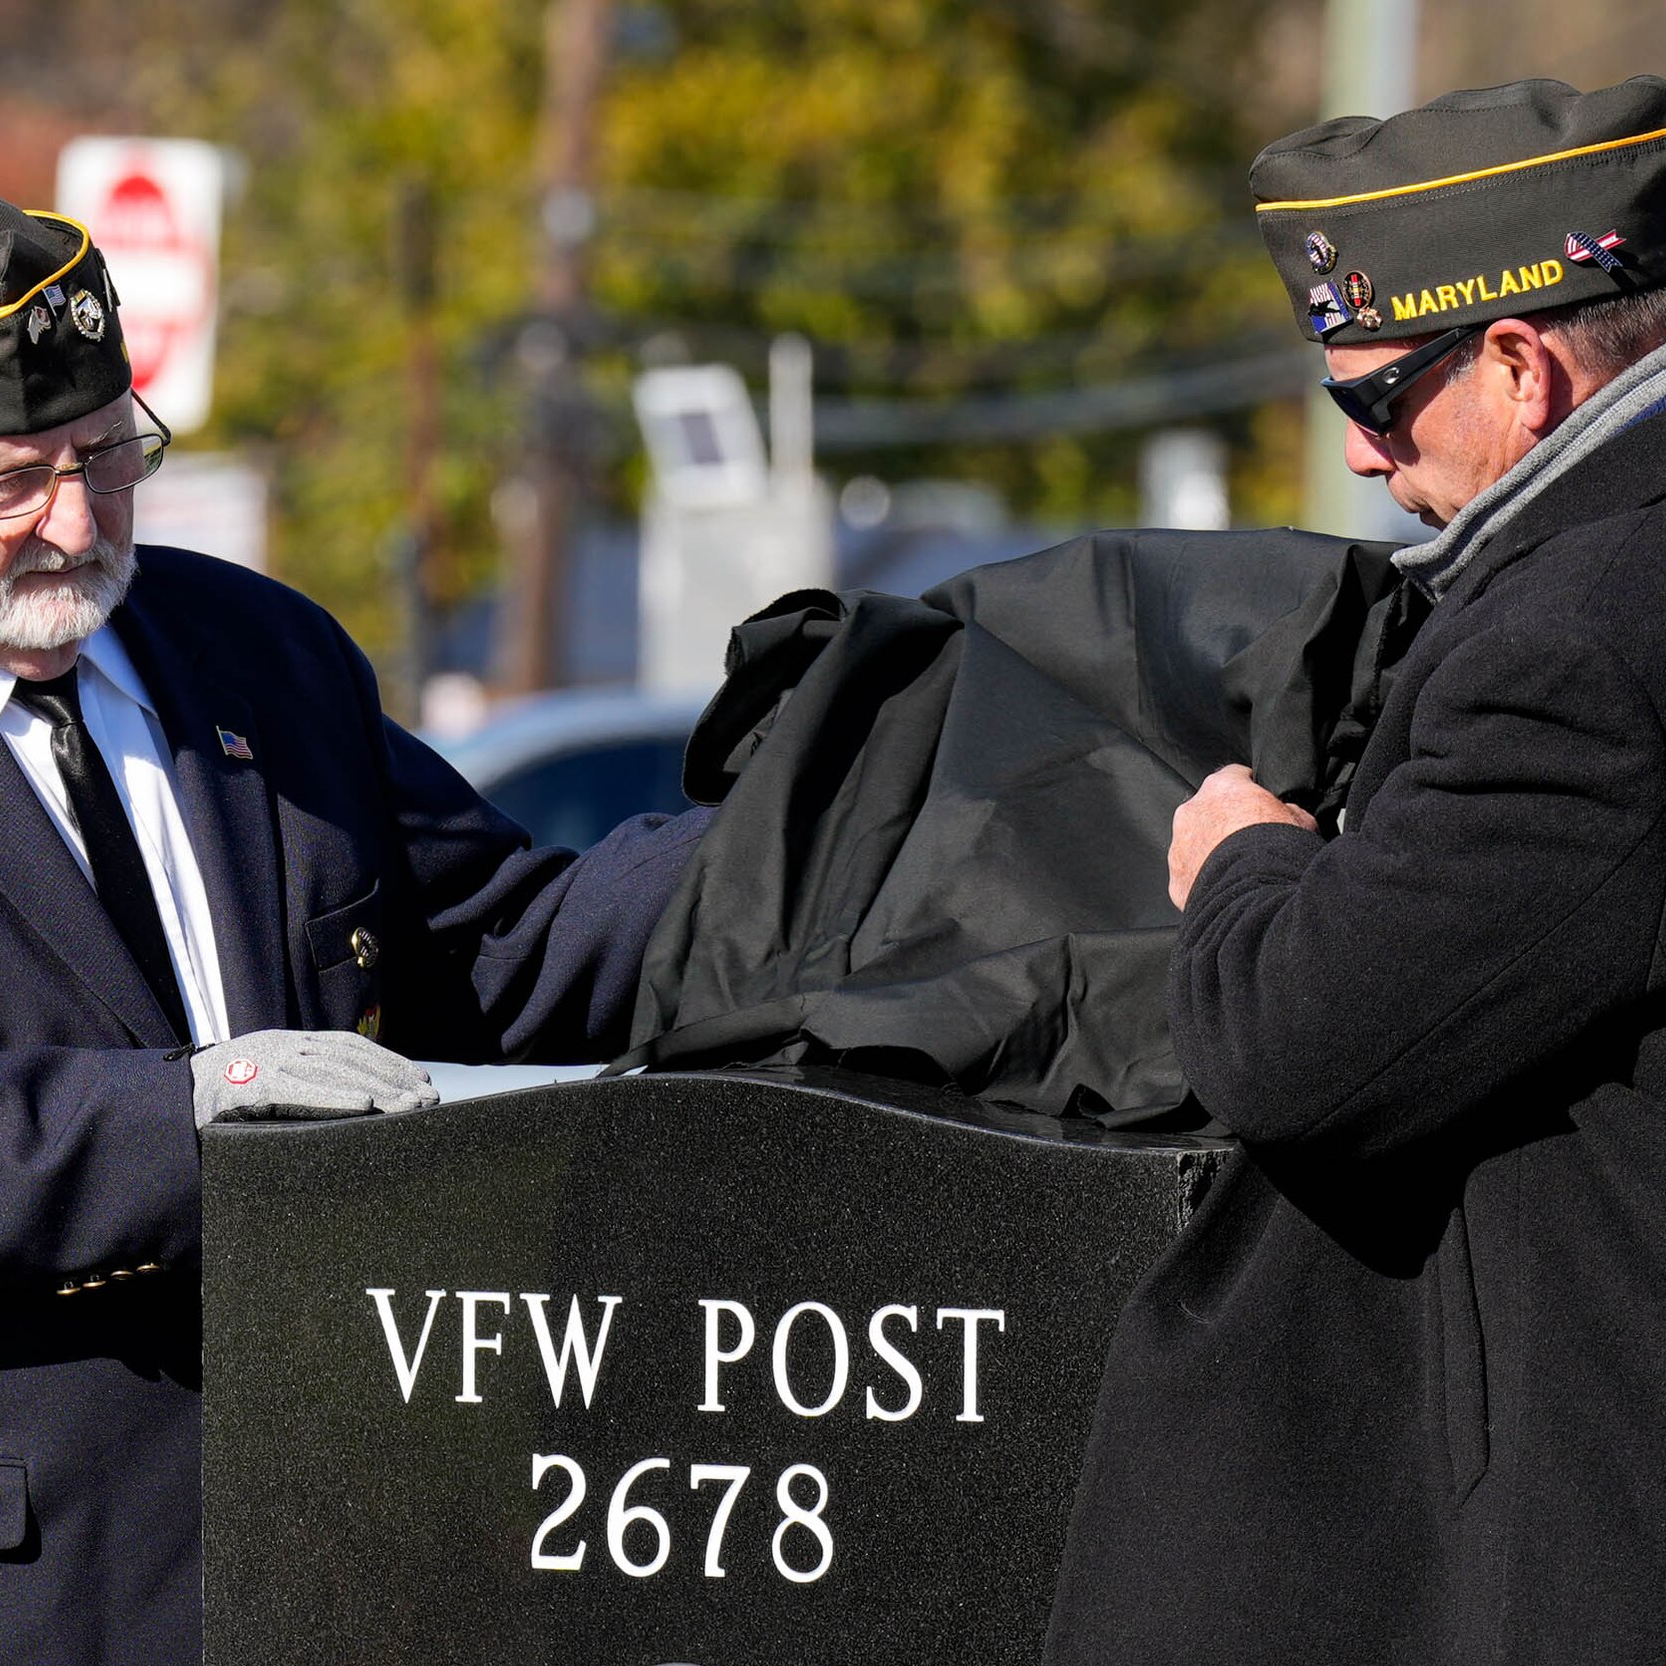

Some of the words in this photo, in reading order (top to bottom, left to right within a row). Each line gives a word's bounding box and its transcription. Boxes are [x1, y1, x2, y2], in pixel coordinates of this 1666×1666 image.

[1391, 259, 1564, 321] MARYLAND
[366, 1288, 623, 1410] VFW
[698, 1299, 1005, 1423] POST
[531, 1453, 834, 1584] 2678
